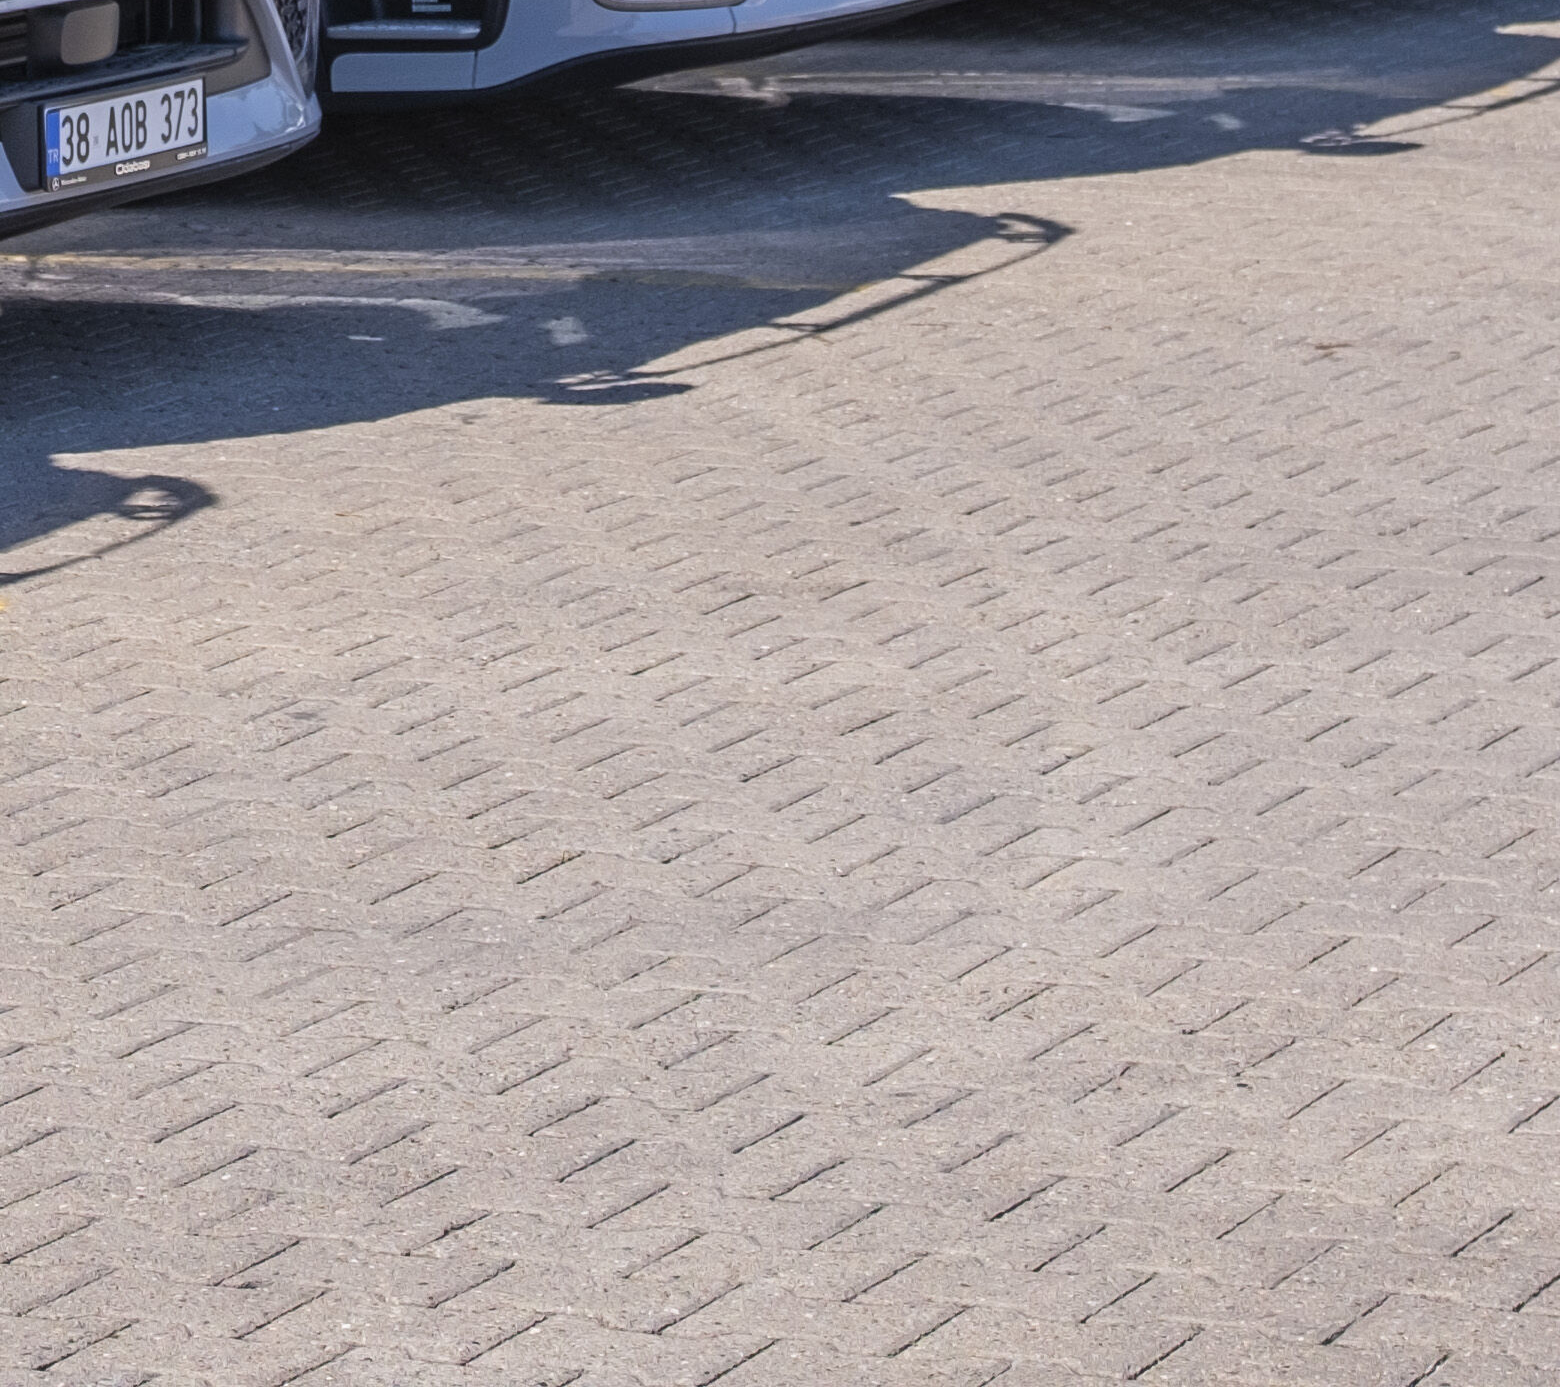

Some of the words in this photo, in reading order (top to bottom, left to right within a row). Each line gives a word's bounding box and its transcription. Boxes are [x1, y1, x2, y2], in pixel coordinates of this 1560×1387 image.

[62, 112, 90, 166] 38
[106, 99, 147, 157] AOB
[160, 87, 199, 145] 373
